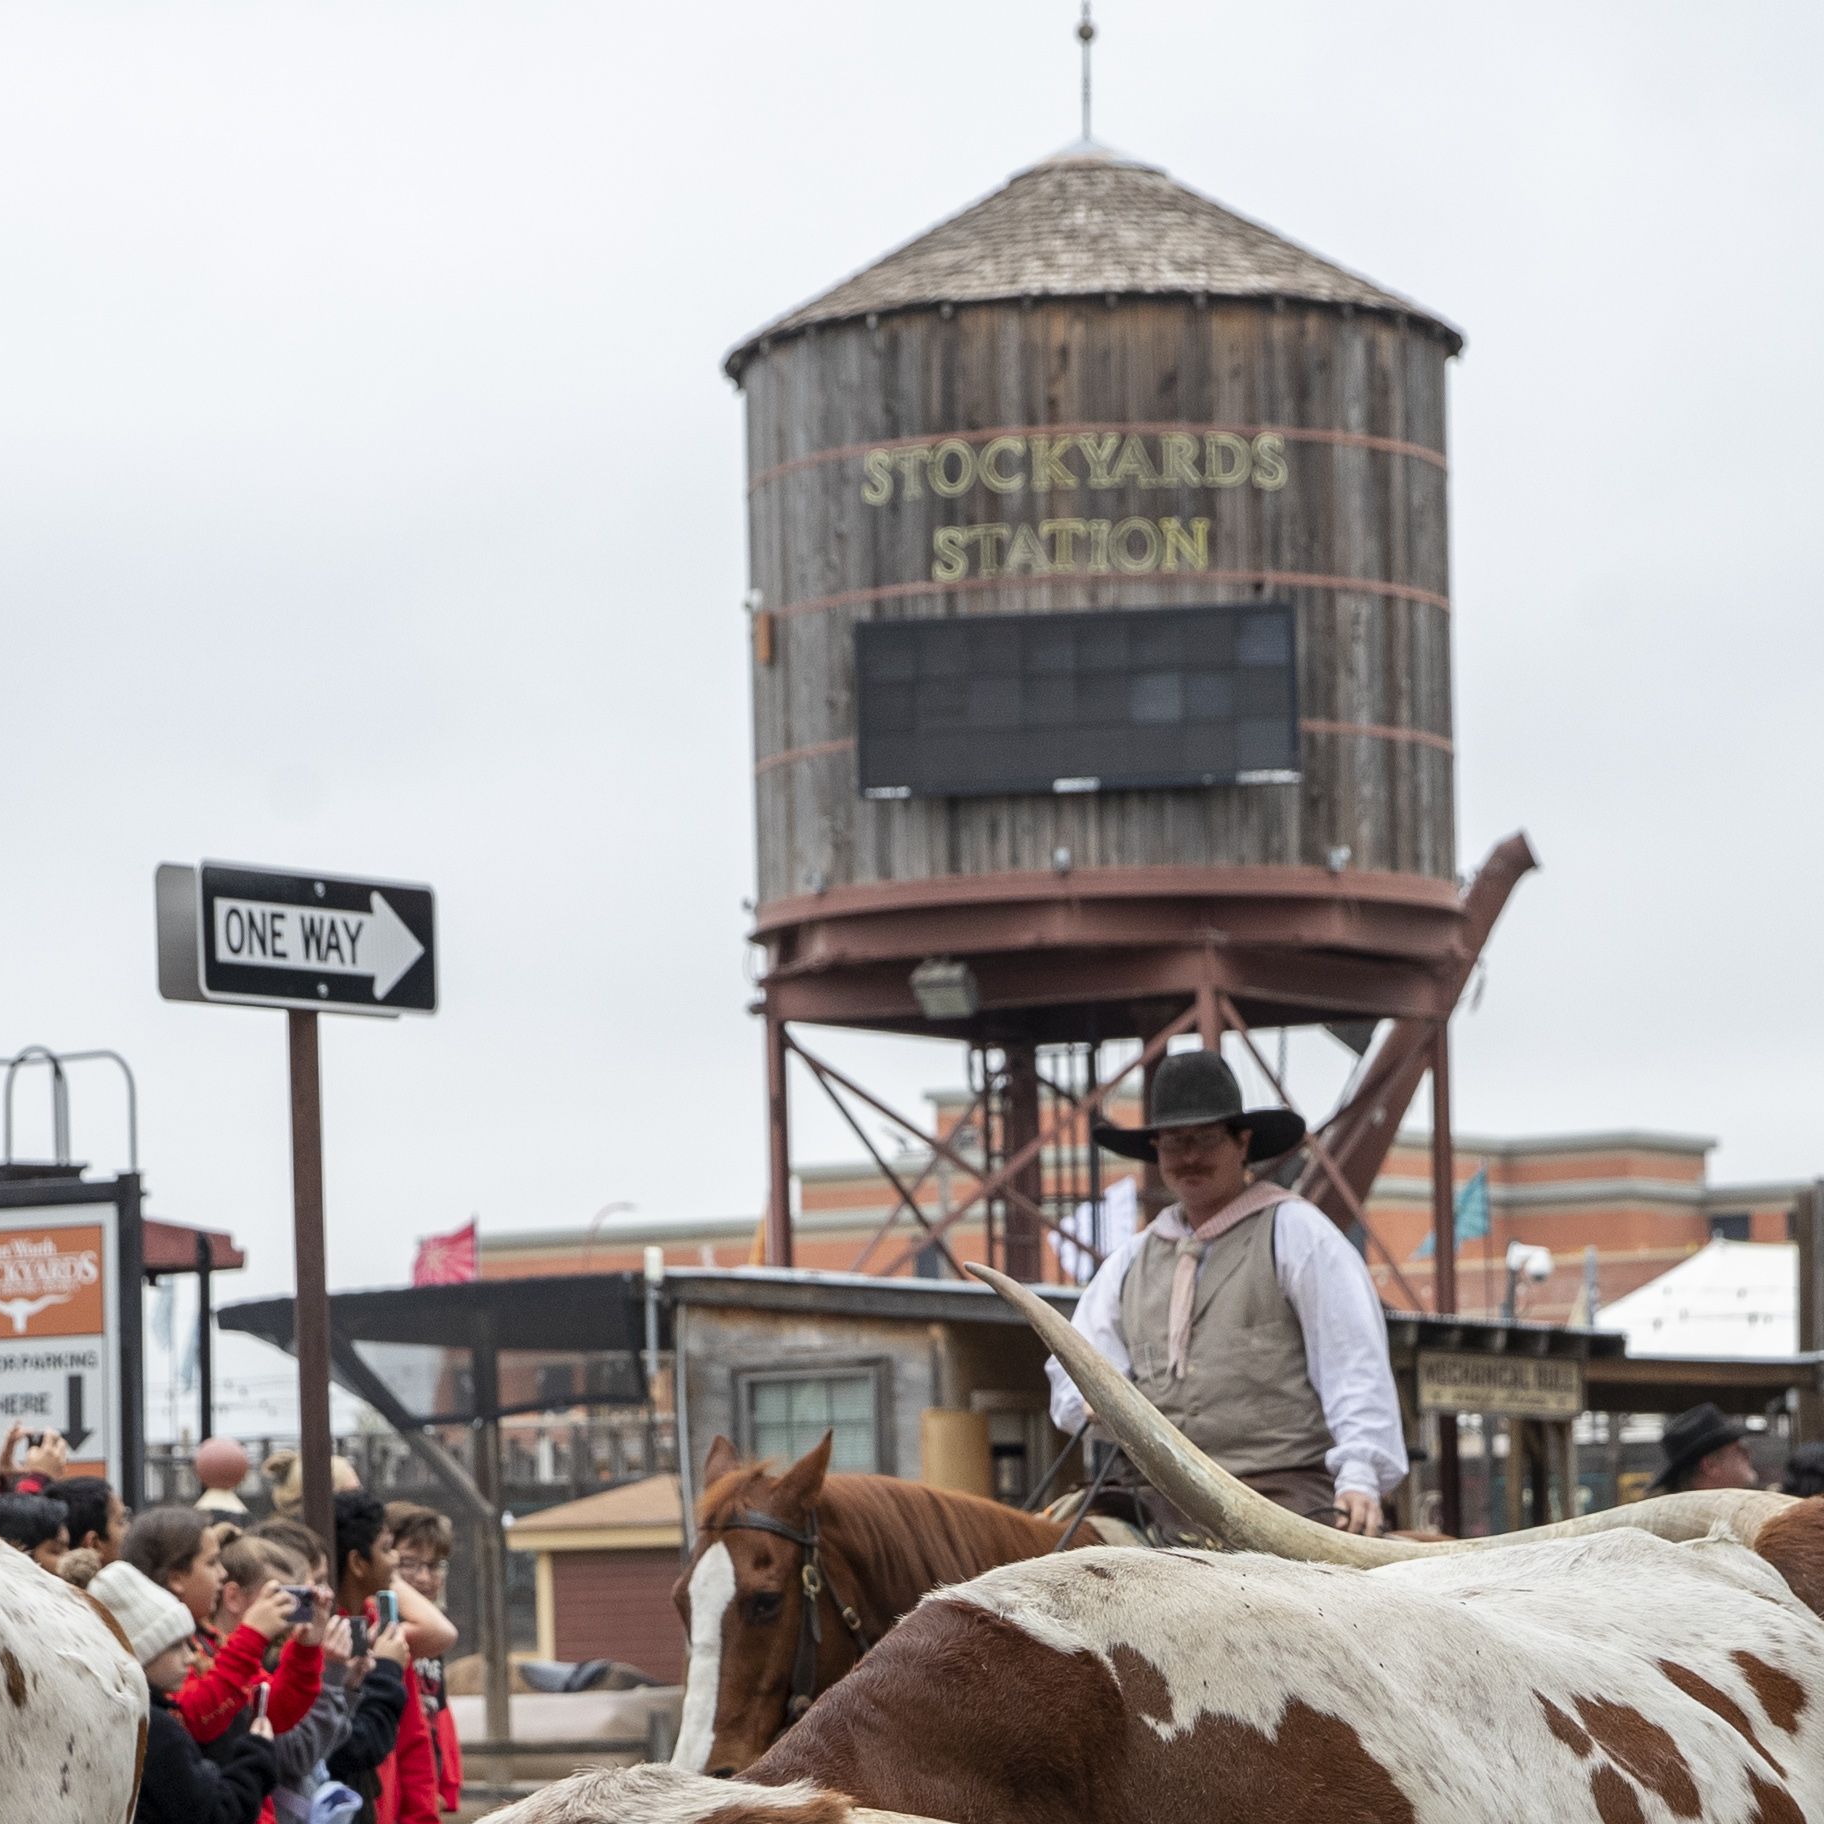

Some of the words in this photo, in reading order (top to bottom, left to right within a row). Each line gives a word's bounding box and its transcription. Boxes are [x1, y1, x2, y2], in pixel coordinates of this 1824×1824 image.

[862, 430, 1288, 506] STOCKYARDS
[932, 516, 1211, 583] STATION
[225, 908, 288, 958] ONE
[300, 914, 363, 965] WAY
[20, 1350, 98, 1370] PARKING
